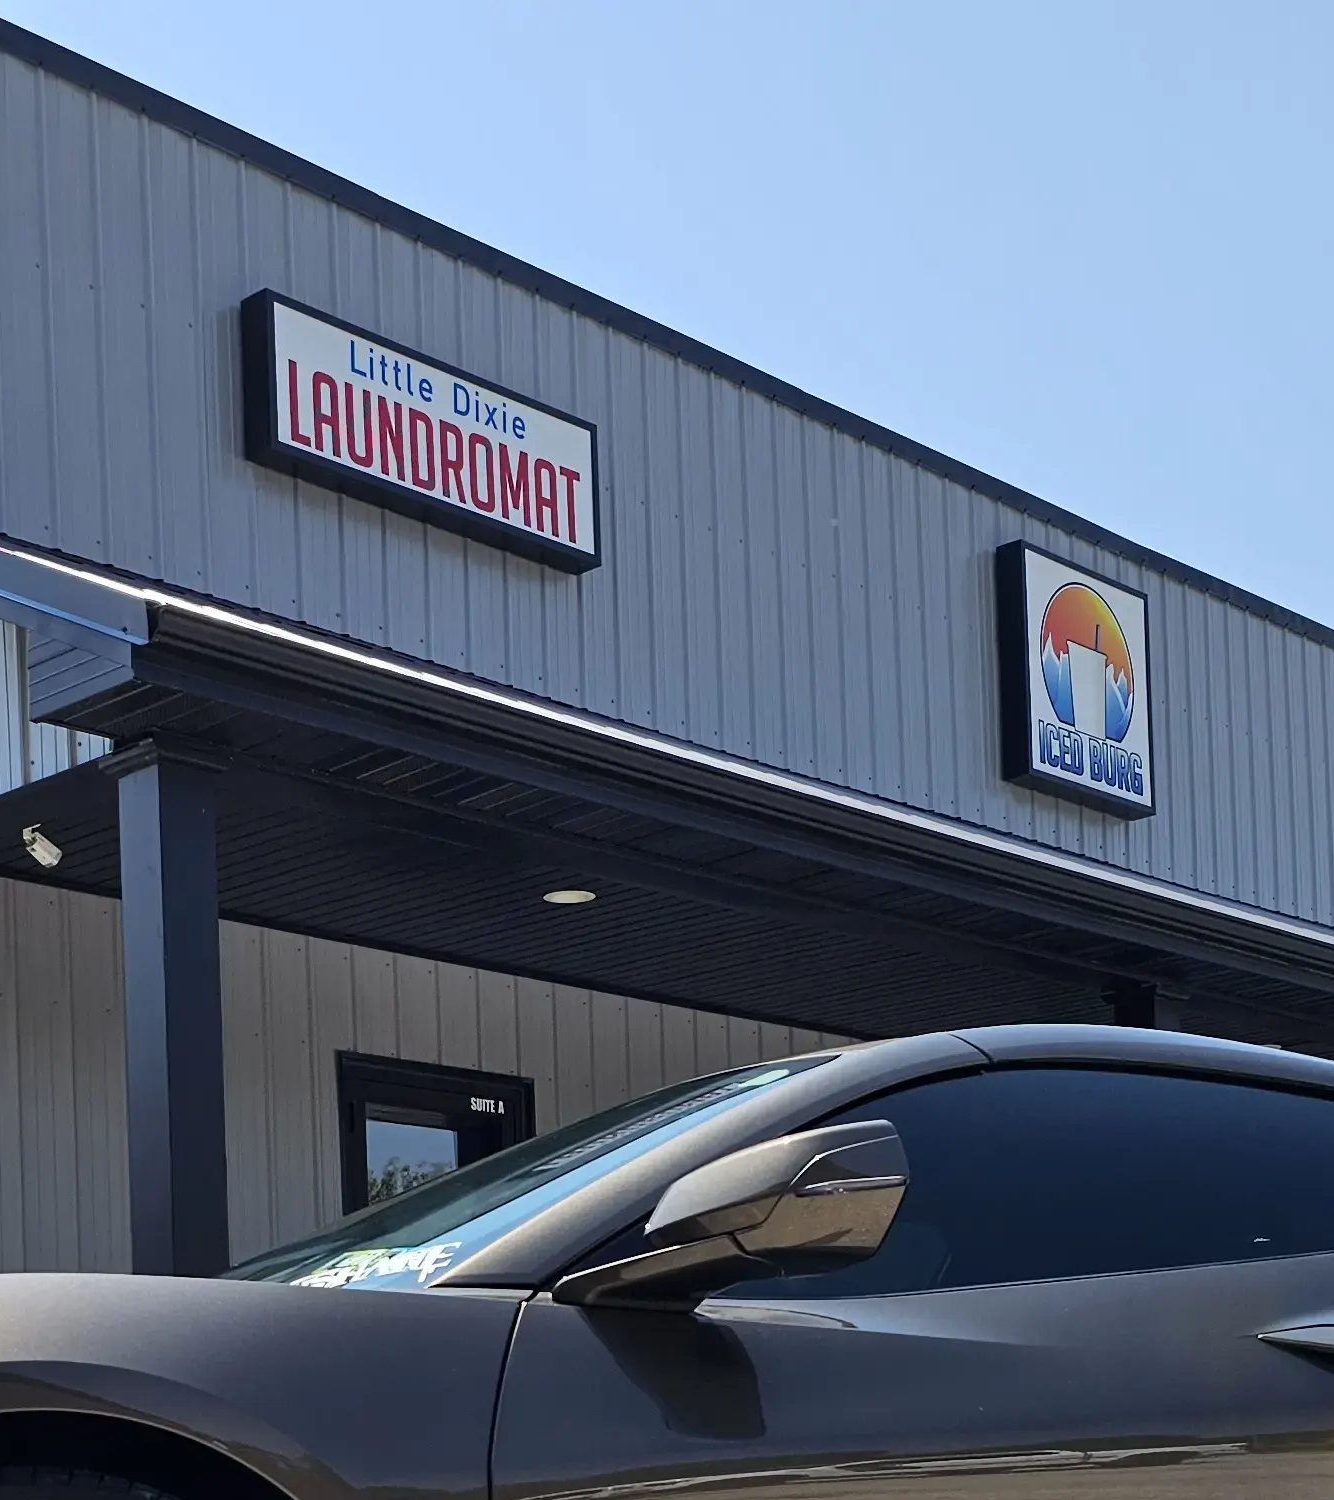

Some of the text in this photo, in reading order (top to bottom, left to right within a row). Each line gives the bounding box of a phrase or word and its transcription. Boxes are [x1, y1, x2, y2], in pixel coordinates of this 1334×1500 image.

[349, 339, 527, 440] Little Dixie
[287, 357, 581, 544] LAUNDROMAT
[1038, 718, 1144, 797] ICED BURG
[470, 1096, 505, 1115] SUITE A
